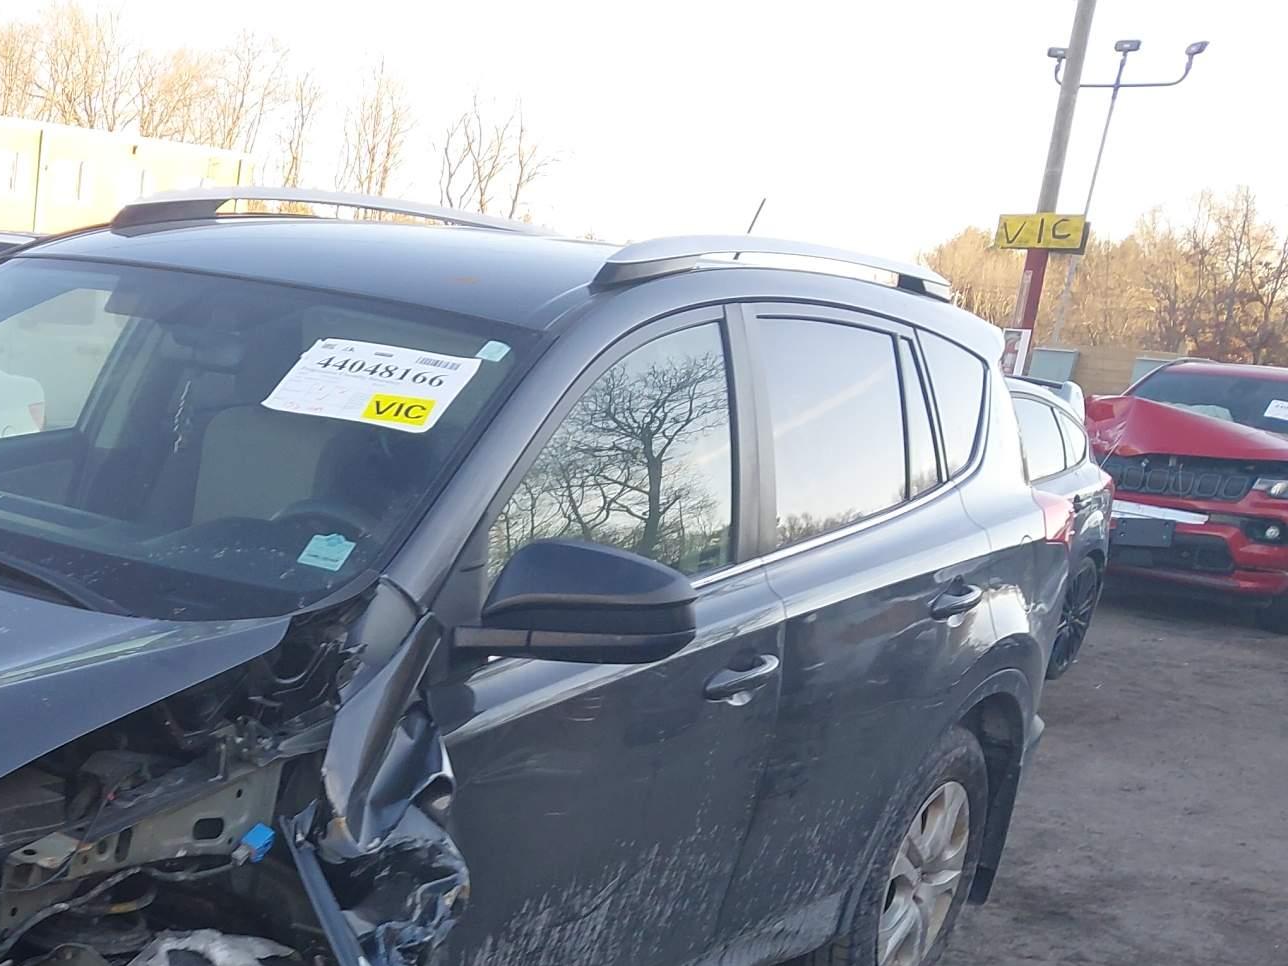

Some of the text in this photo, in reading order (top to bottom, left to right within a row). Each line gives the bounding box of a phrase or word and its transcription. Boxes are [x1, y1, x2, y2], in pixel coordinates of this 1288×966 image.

[1003, 218, 1071, 244] VIC
[316, 355, 449, 388] 44048166
[375, 400, 427, 420] VIC
